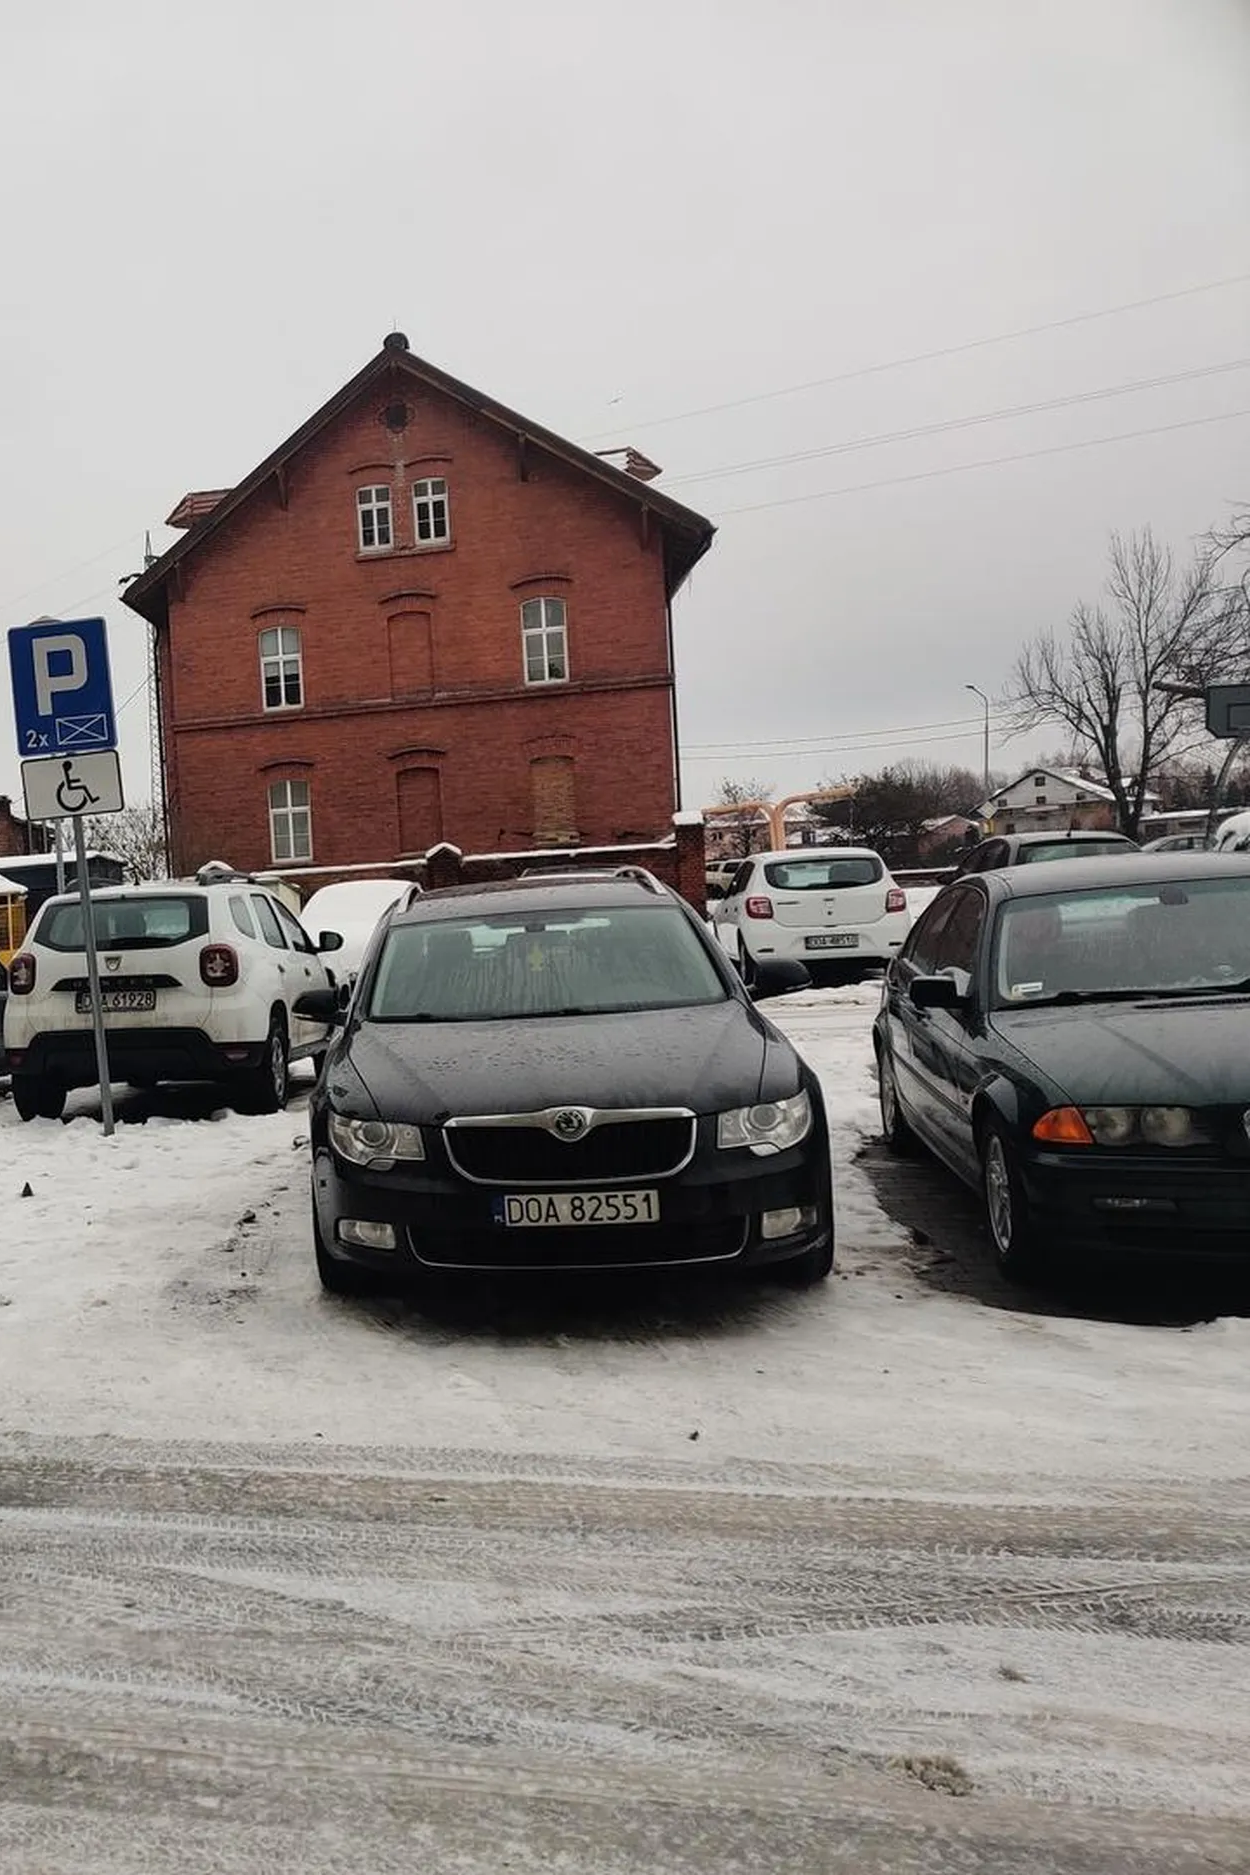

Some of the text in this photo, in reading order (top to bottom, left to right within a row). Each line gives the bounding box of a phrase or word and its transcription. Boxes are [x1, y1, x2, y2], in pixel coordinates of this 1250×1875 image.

[33, 635, 88, 716] P
[26, 730, 49, 749] 2x
[83, 992, 152, 1007] DA 61928
[507, 1193, 652, 1224] DOA 82551
